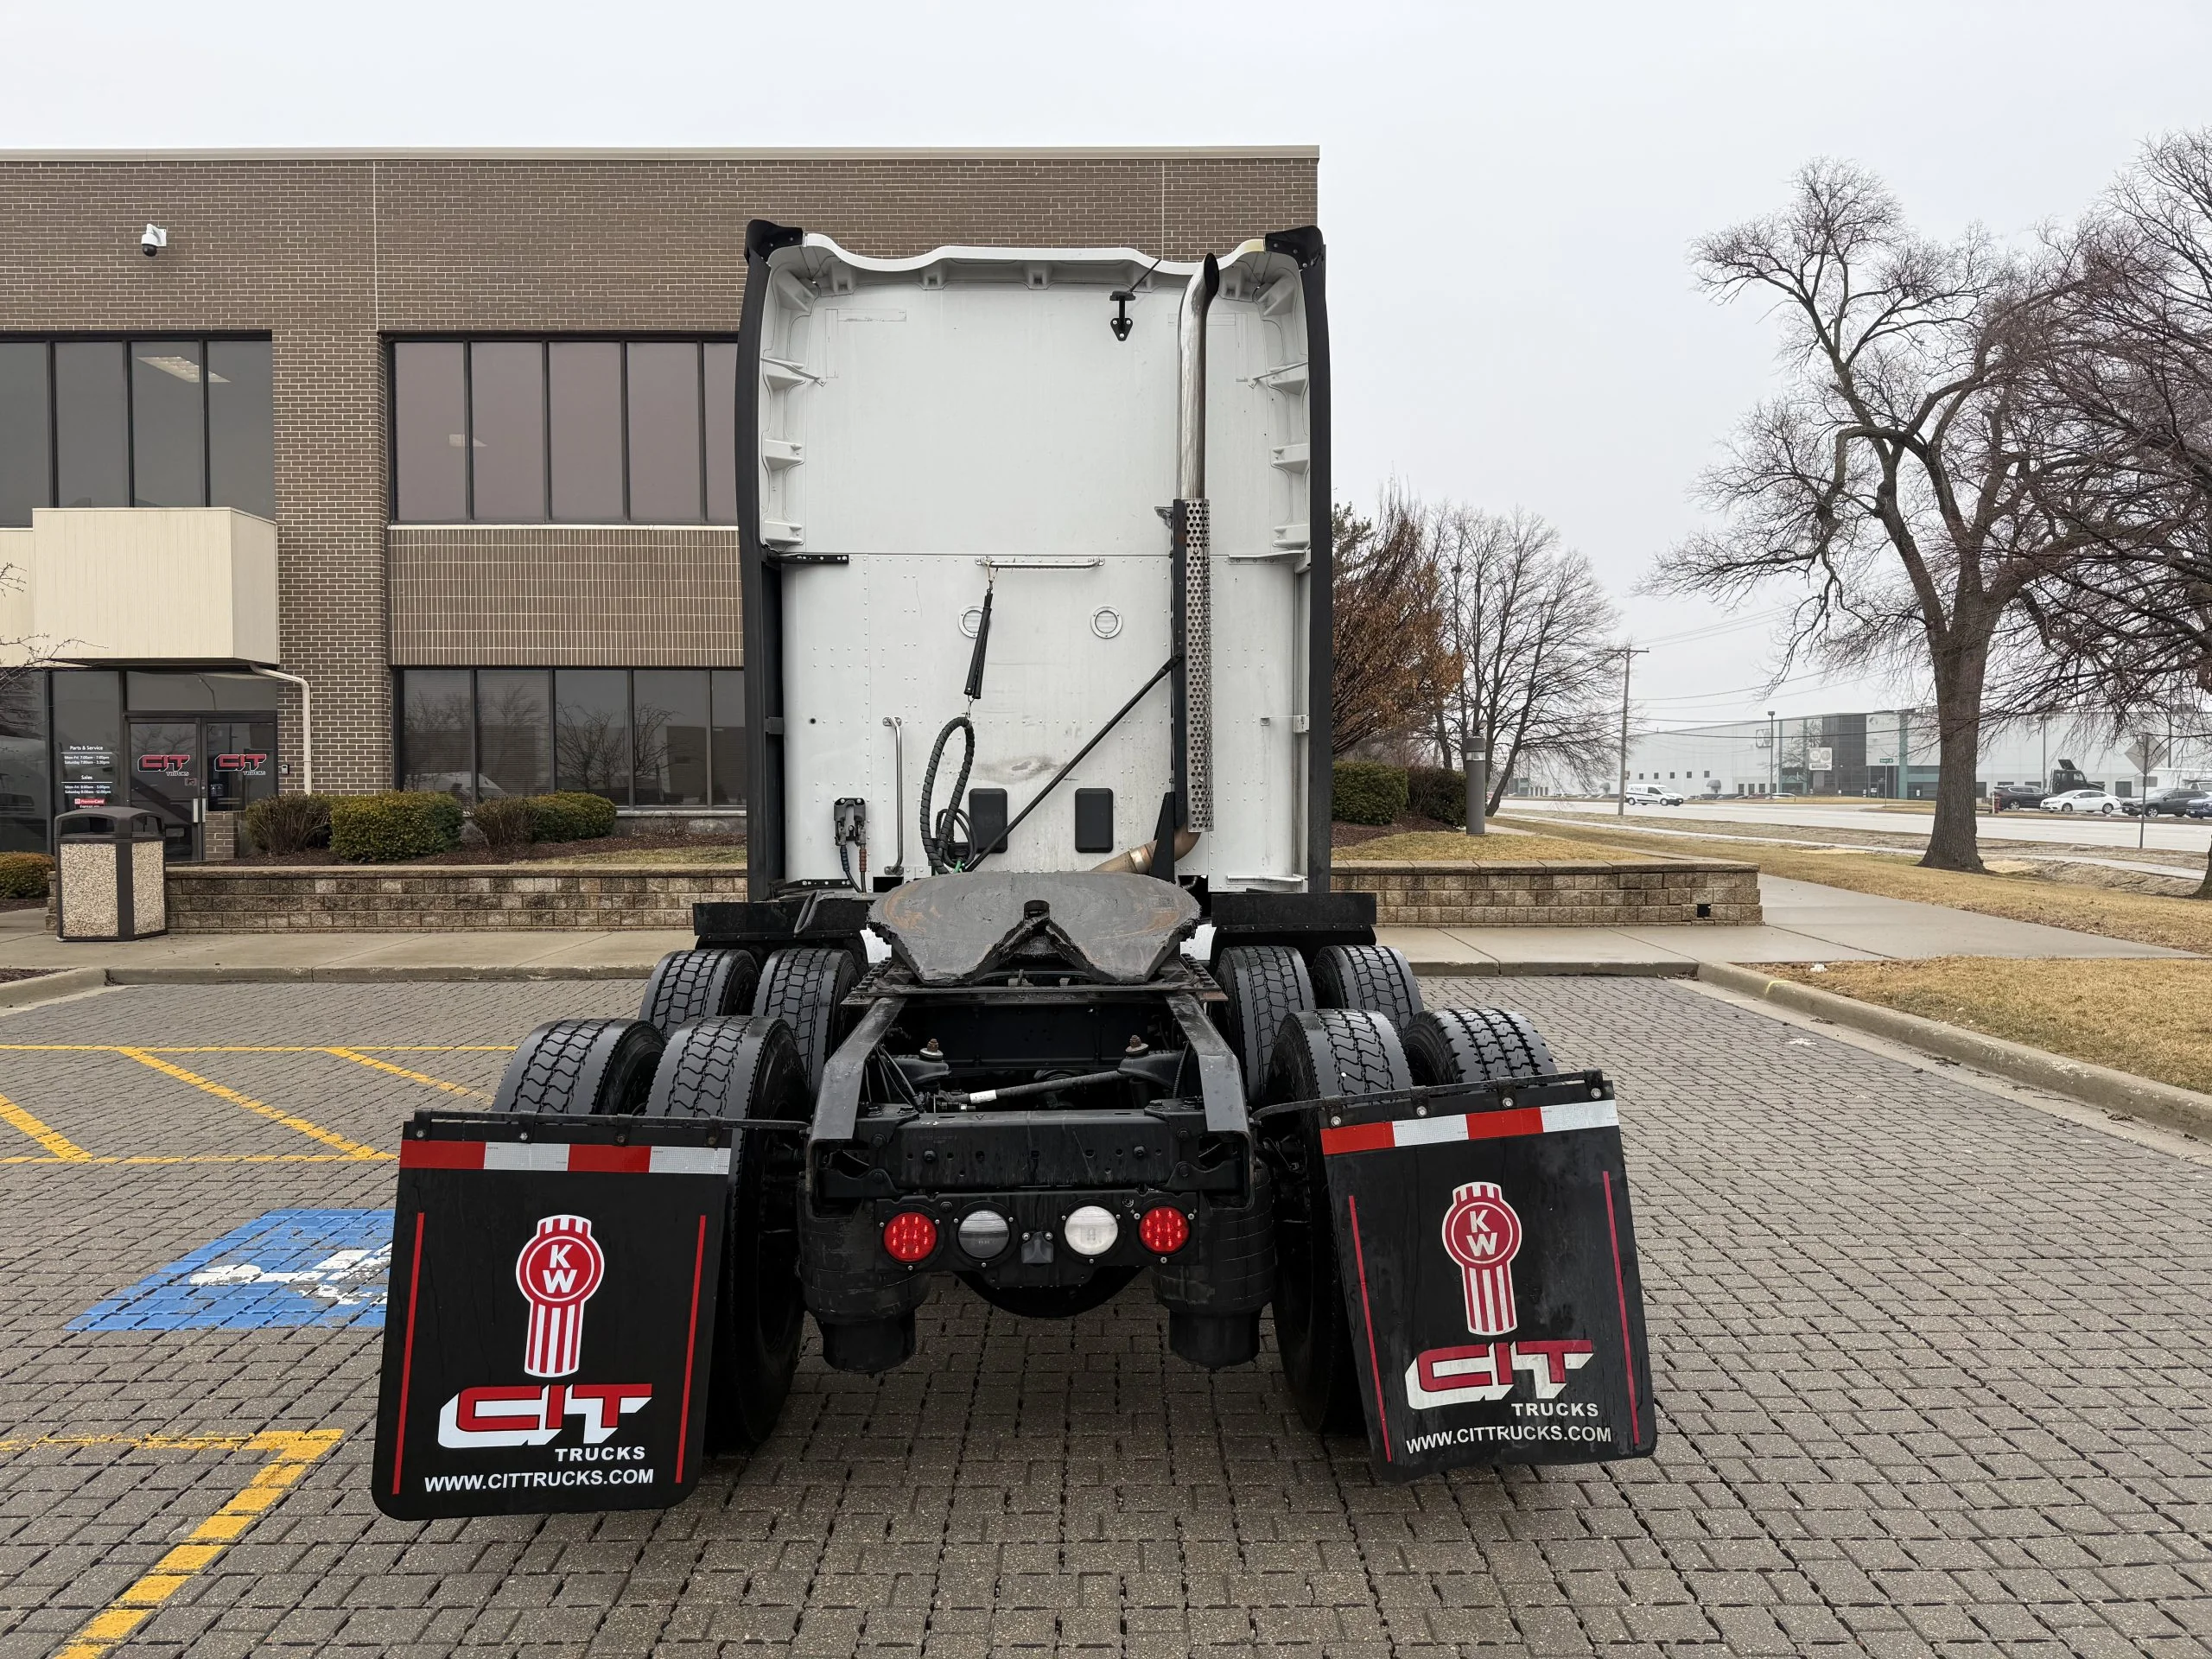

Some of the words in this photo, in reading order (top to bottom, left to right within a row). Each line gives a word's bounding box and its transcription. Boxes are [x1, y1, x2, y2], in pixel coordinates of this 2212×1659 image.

[137, 754, 190, 772] CIT
[214, 753, 267, 772] CIT
[1405, 1339, 1594, 1410] CIT
[438, 1383, 652, 1448] CIT
[1511, 1402, 1599, 1417] TRUCKS
[1406, 1425, 1611, 1454] WWW.CITTRUCKS.COM
[555, 1446, 645, 1462] TRUCKS
[424, 1468, 654, 1492] WWW.CITTRUCKS.COM
